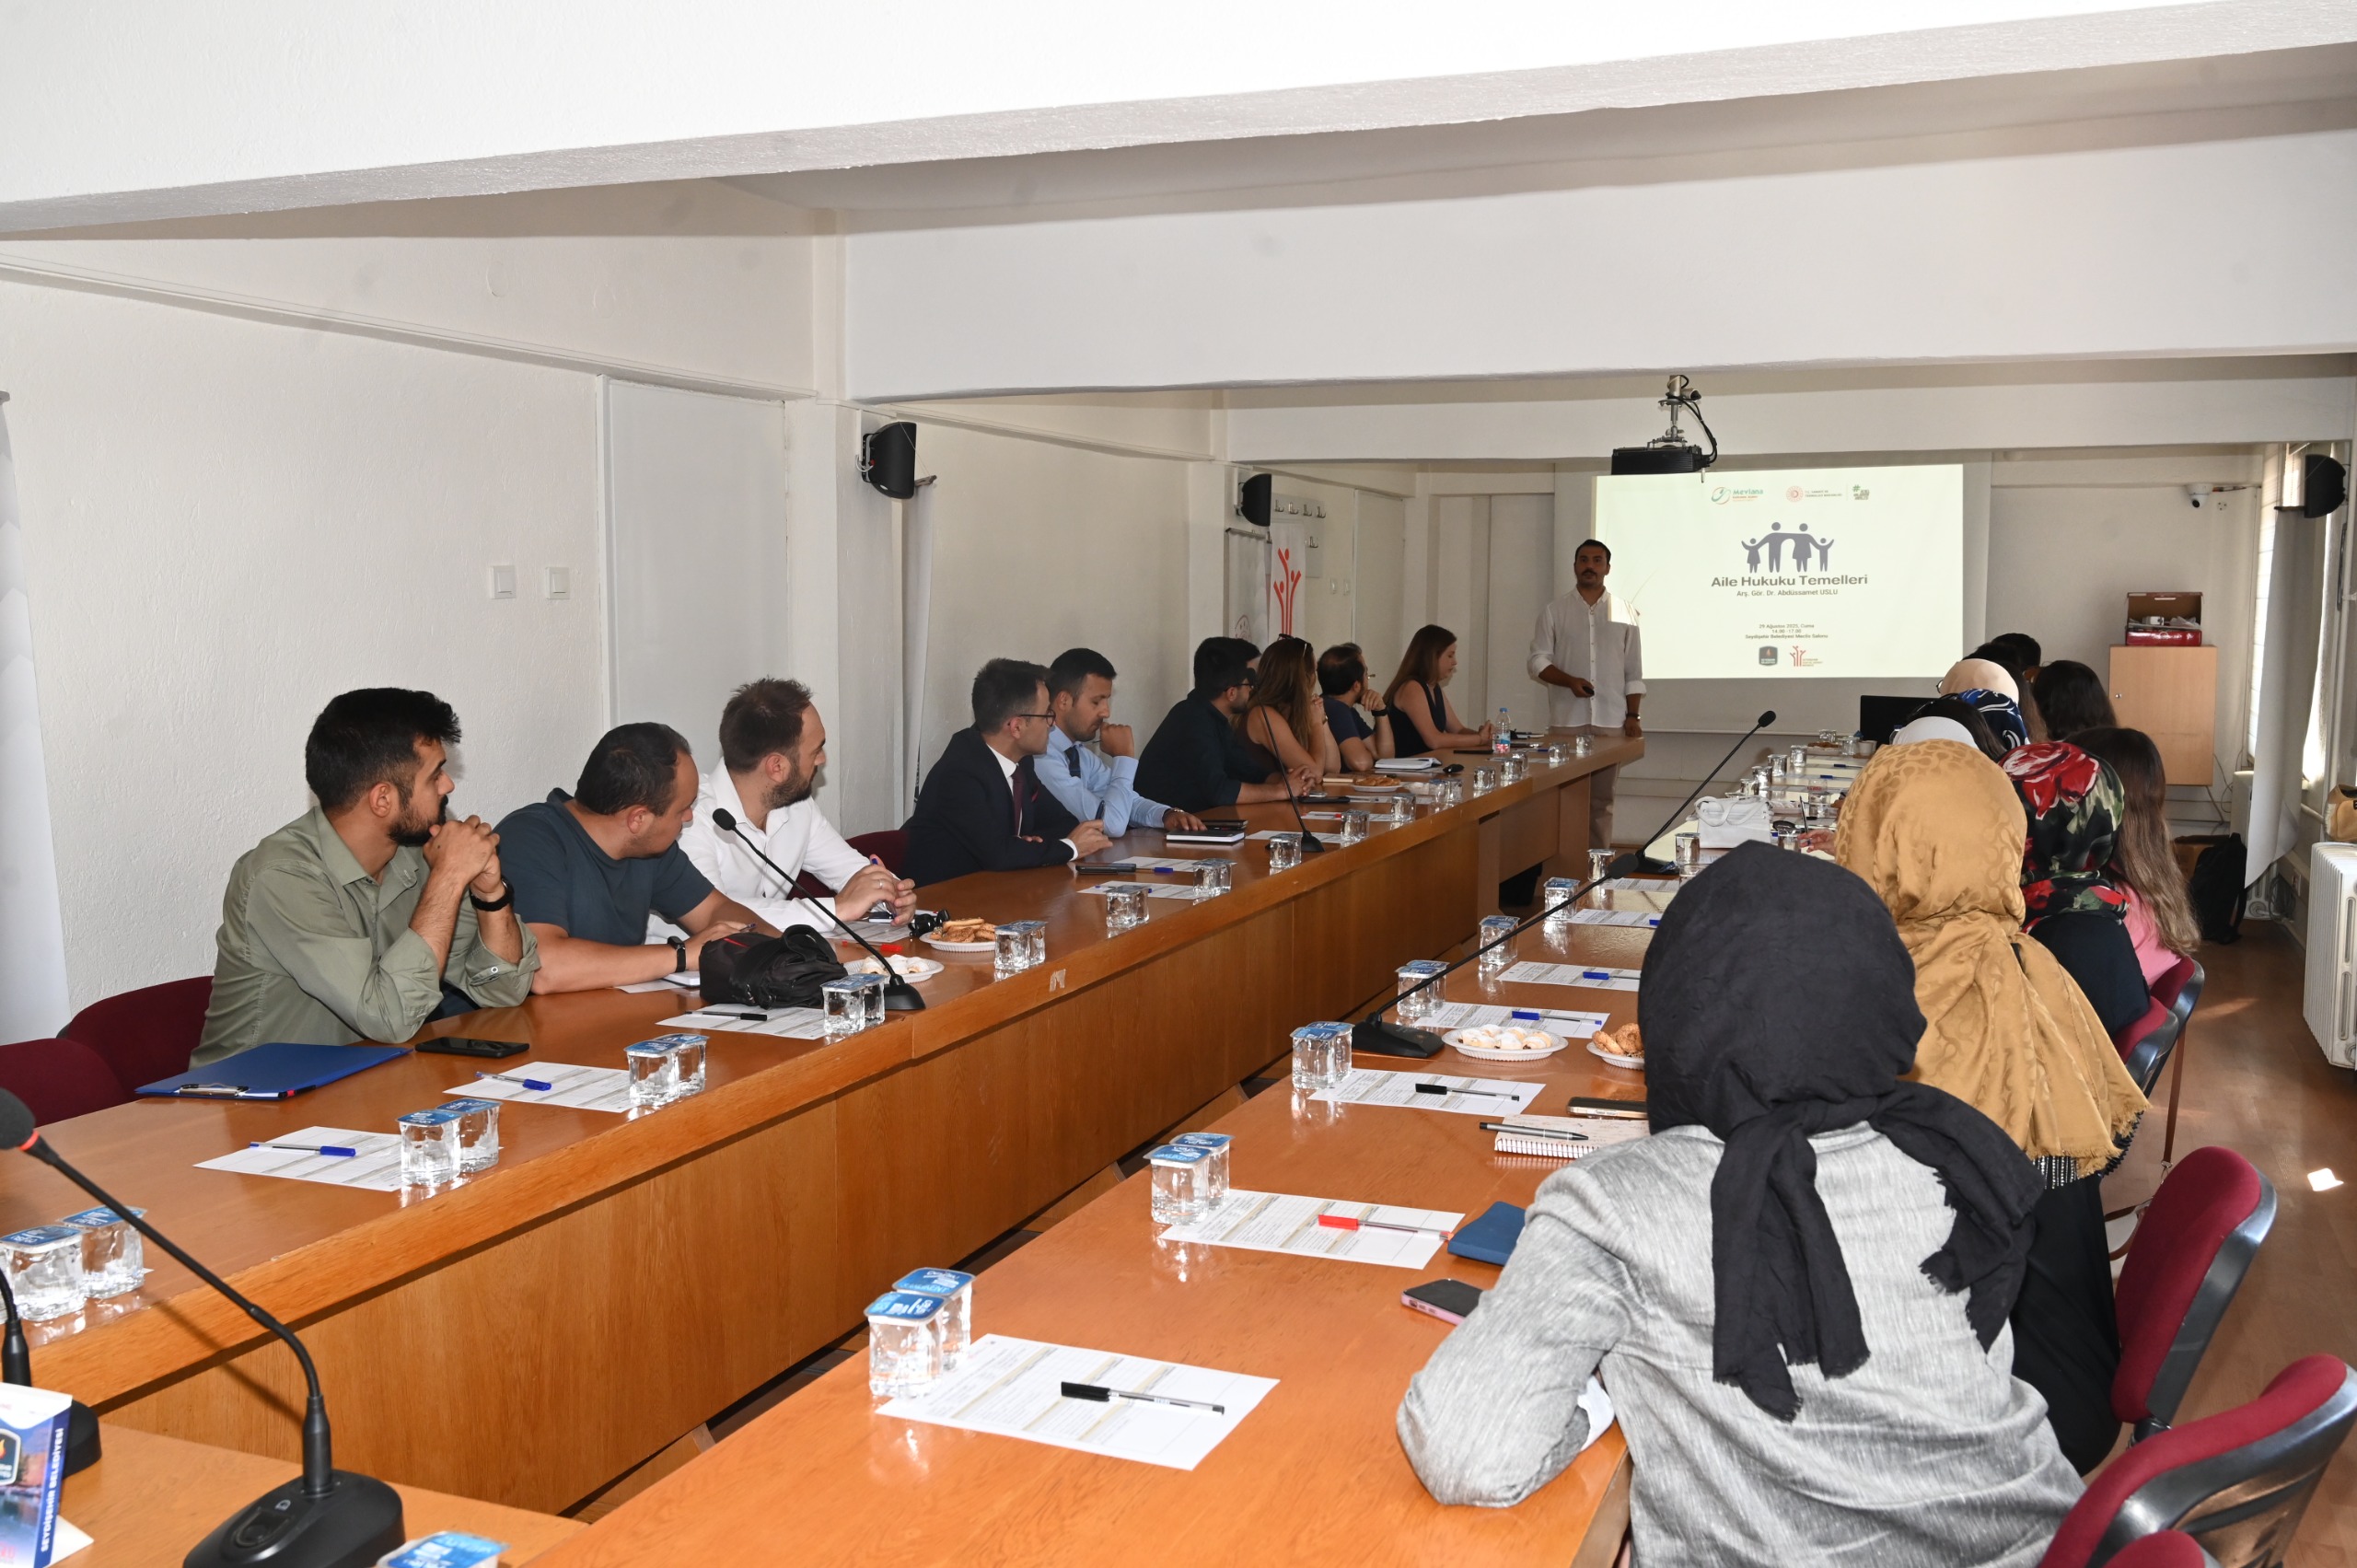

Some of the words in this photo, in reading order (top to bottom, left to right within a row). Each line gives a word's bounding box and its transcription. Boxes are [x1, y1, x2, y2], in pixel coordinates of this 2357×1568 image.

[1712, 577, 1737, 587] Aile
[1741, 575, 1795, 587] Hukuku
[1799, 575, 1868, 586] Temelleri
